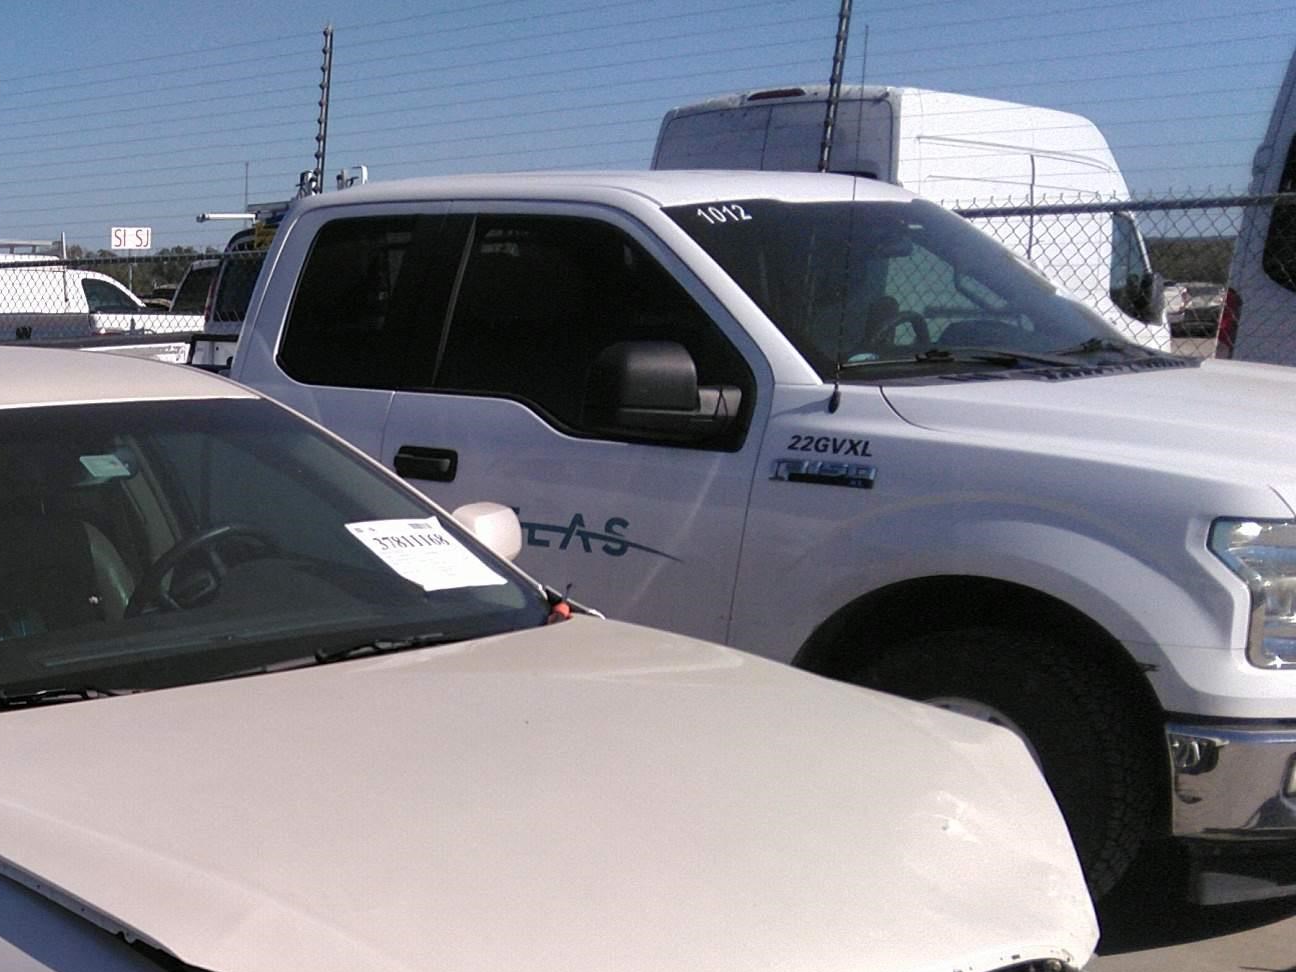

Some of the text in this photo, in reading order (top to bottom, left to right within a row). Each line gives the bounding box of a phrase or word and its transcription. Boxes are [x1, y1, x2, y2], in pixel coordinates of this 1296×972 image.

[697, 204, 752, 224] 1012
[135, 228, 149, 248] SJ
[787, 434, 873, 457] 22GVXL
[373, 532, 451, 551] 37811168
